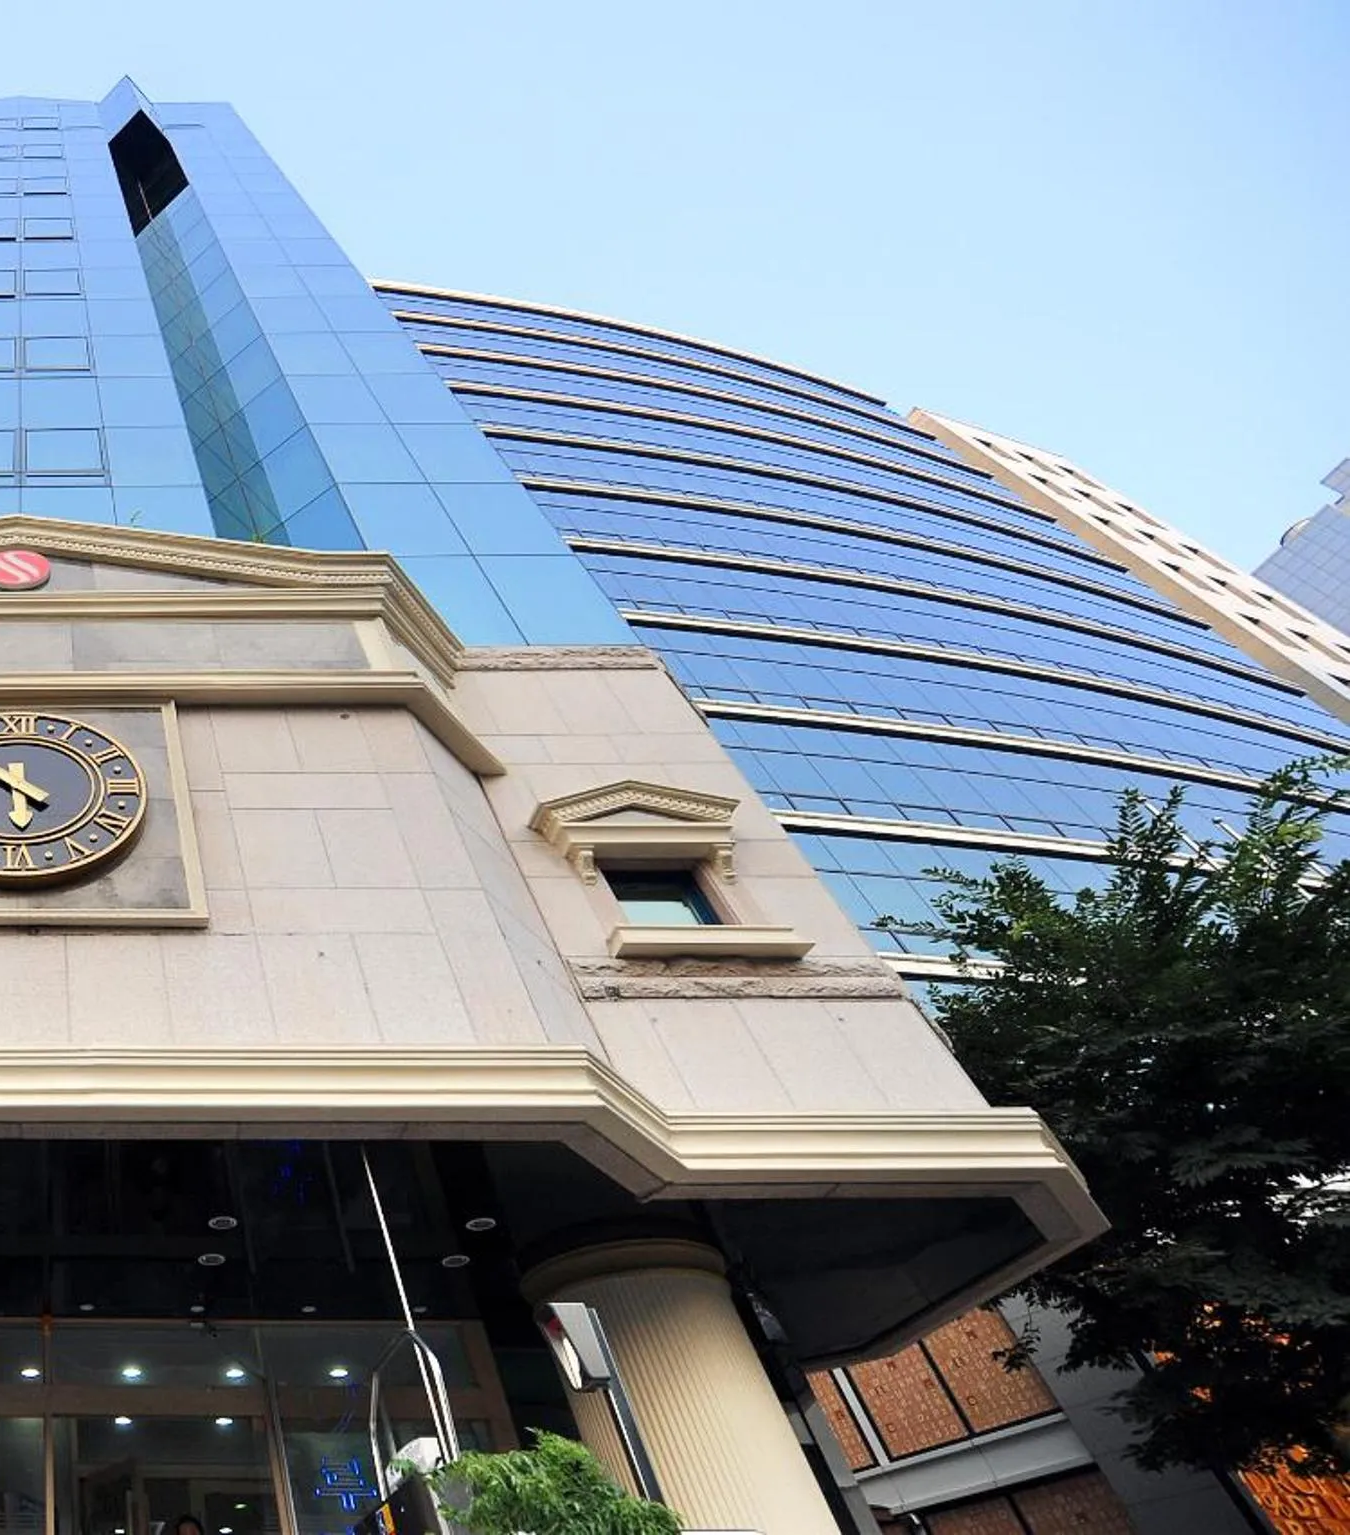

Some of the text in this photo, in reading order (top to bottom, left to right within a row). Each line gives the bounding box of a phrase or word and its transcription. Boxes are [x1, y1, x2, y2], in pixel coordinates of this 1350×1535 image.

[0, 715, 39, 735] XII
[61, 723, 82, 740] I
[95, 745, 124, 764] II
[107, 777, 139, 796] III
[94, 808, 134, 839] IV
[3, 843, 38, 870] VI
[63, 836, 95, 863] V
